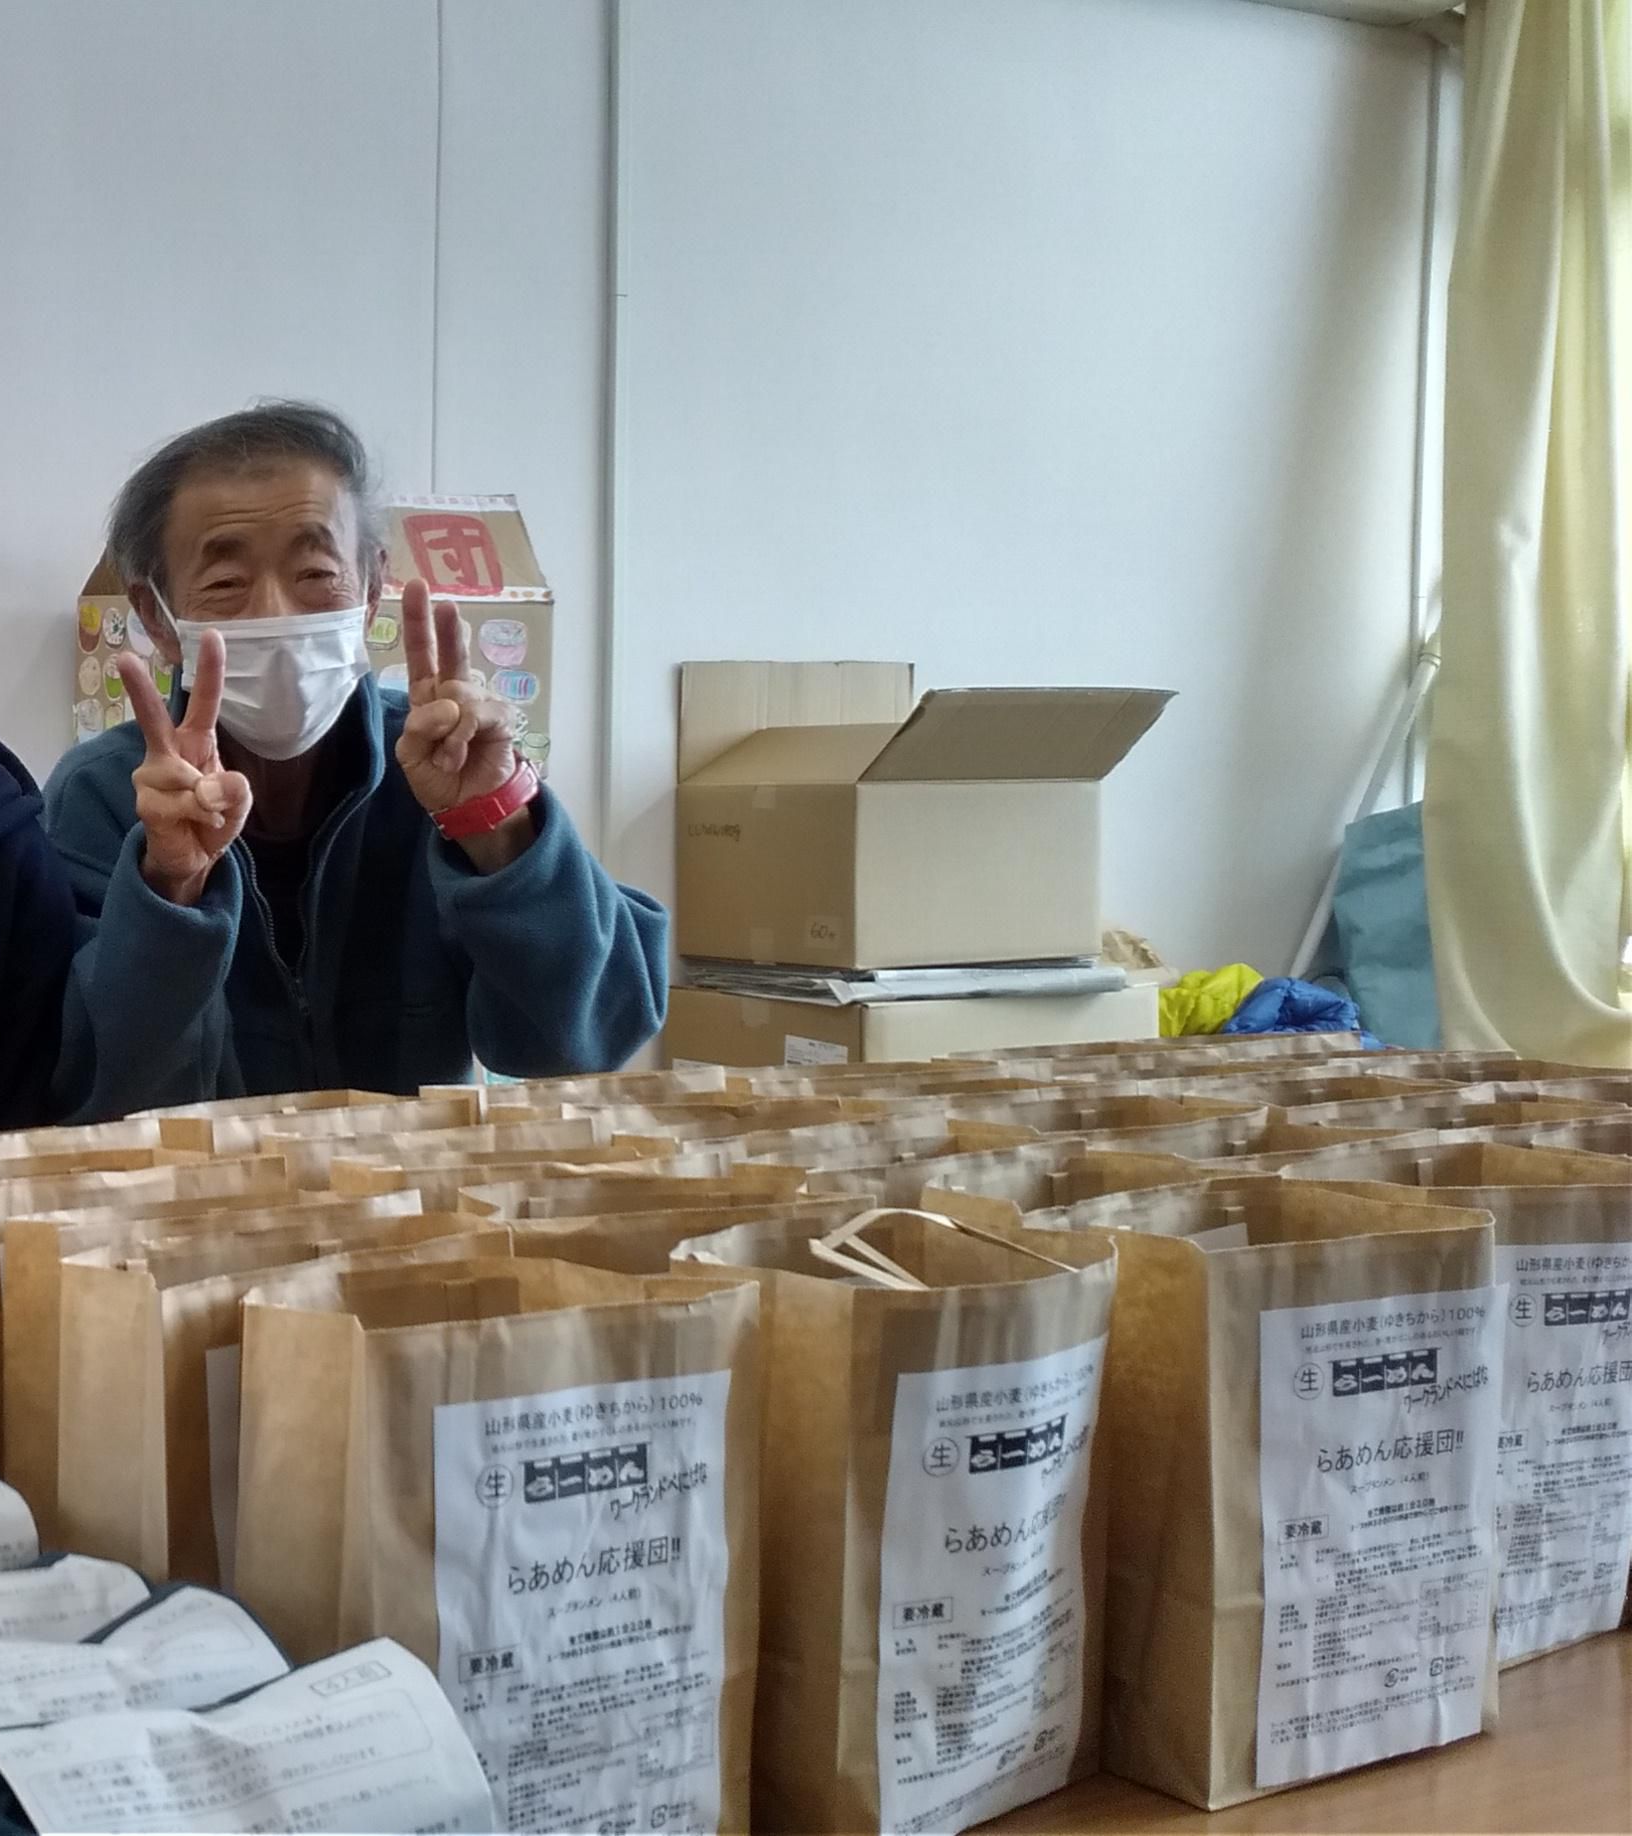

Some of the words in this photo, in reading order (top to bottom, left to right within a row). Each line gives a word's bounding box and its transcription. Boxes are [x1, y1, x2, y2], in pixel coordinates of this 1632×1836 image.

[1284, 1519, 1324, 1538] 要冷蔵
[901, 1603, 946, 1623] 要冷蔵
[468, 1651, 516, 1676] 要冷蔵
